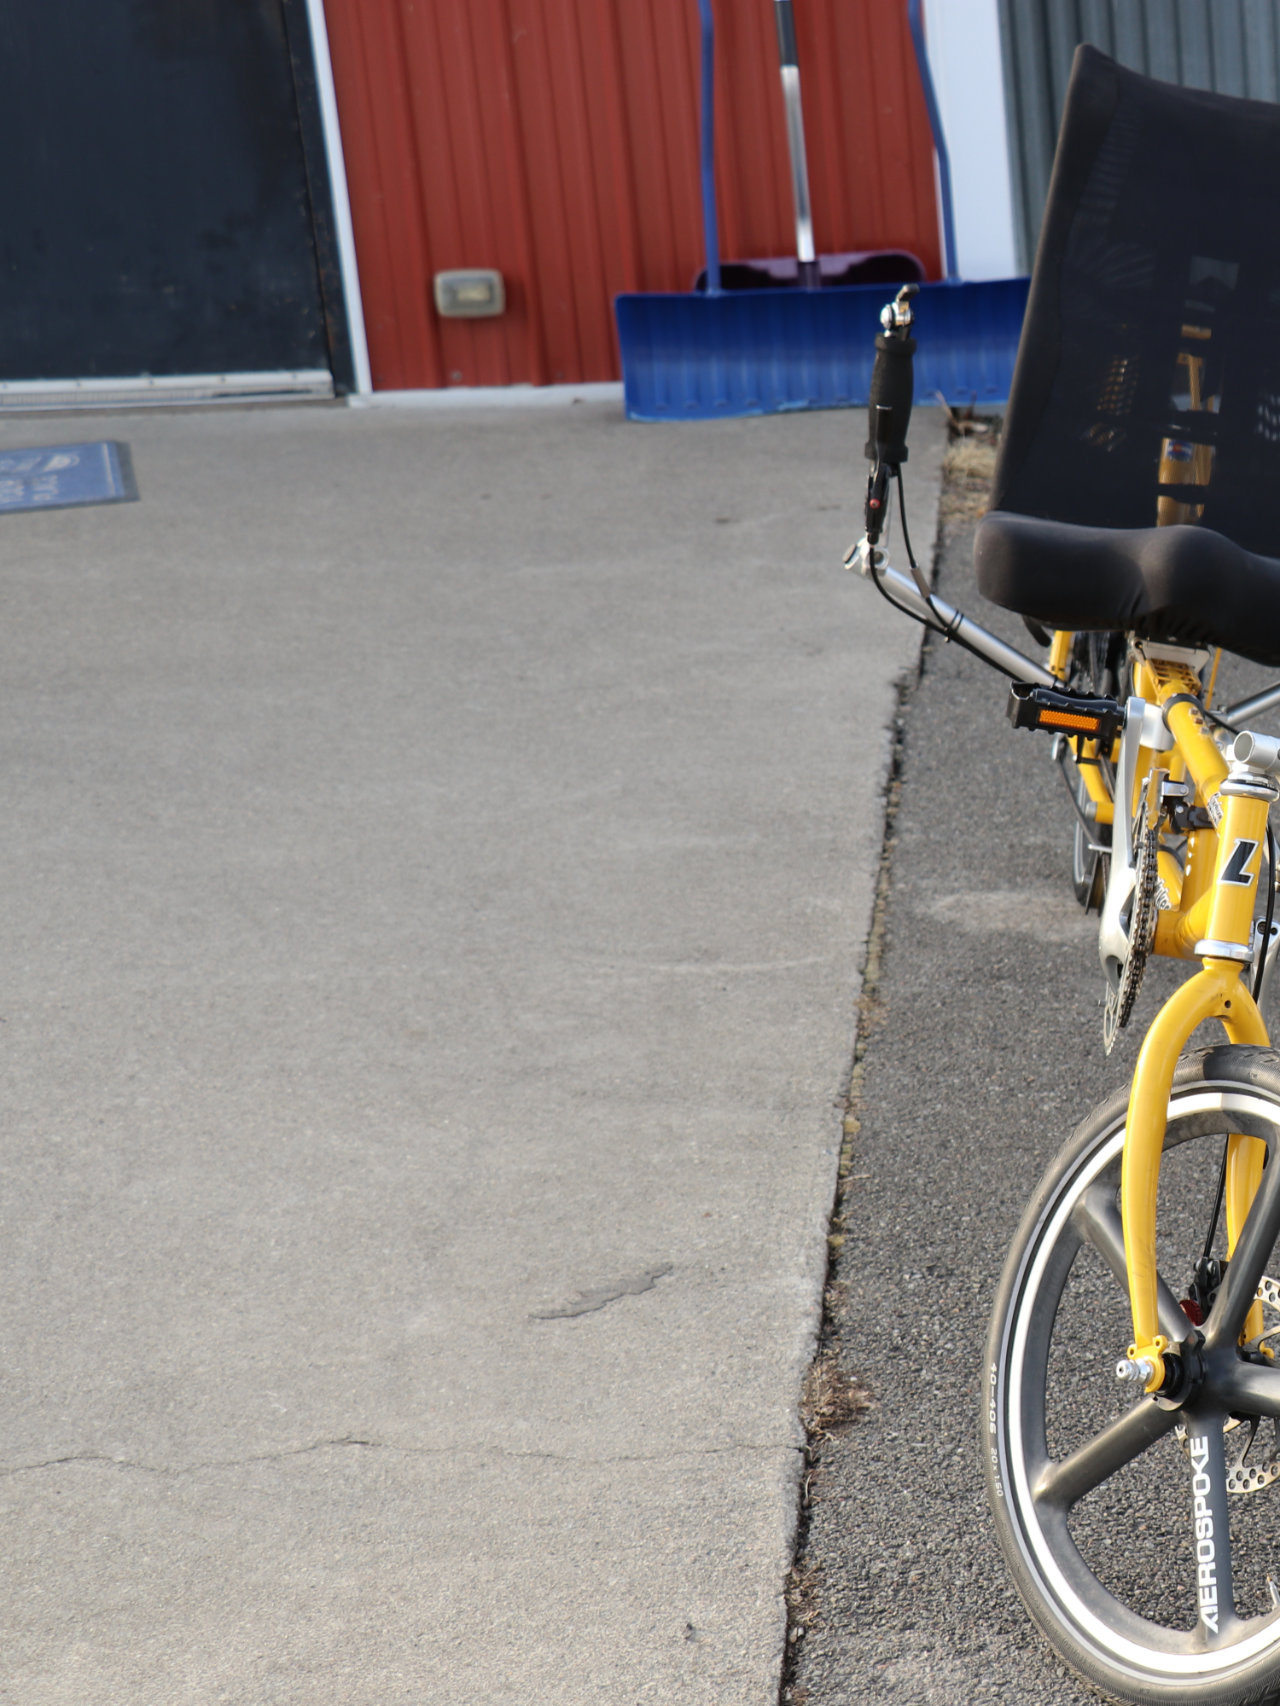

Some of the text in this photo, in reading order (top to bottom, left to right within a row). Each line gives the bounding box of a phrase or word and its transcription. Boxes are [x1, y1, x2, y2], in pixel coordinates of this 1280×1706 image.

[1217, 838, 1259, 887] L
[989, 1362, 998, 1435] 40-406
[1190, 1436, 1219, 1634] AEROSPOKE
